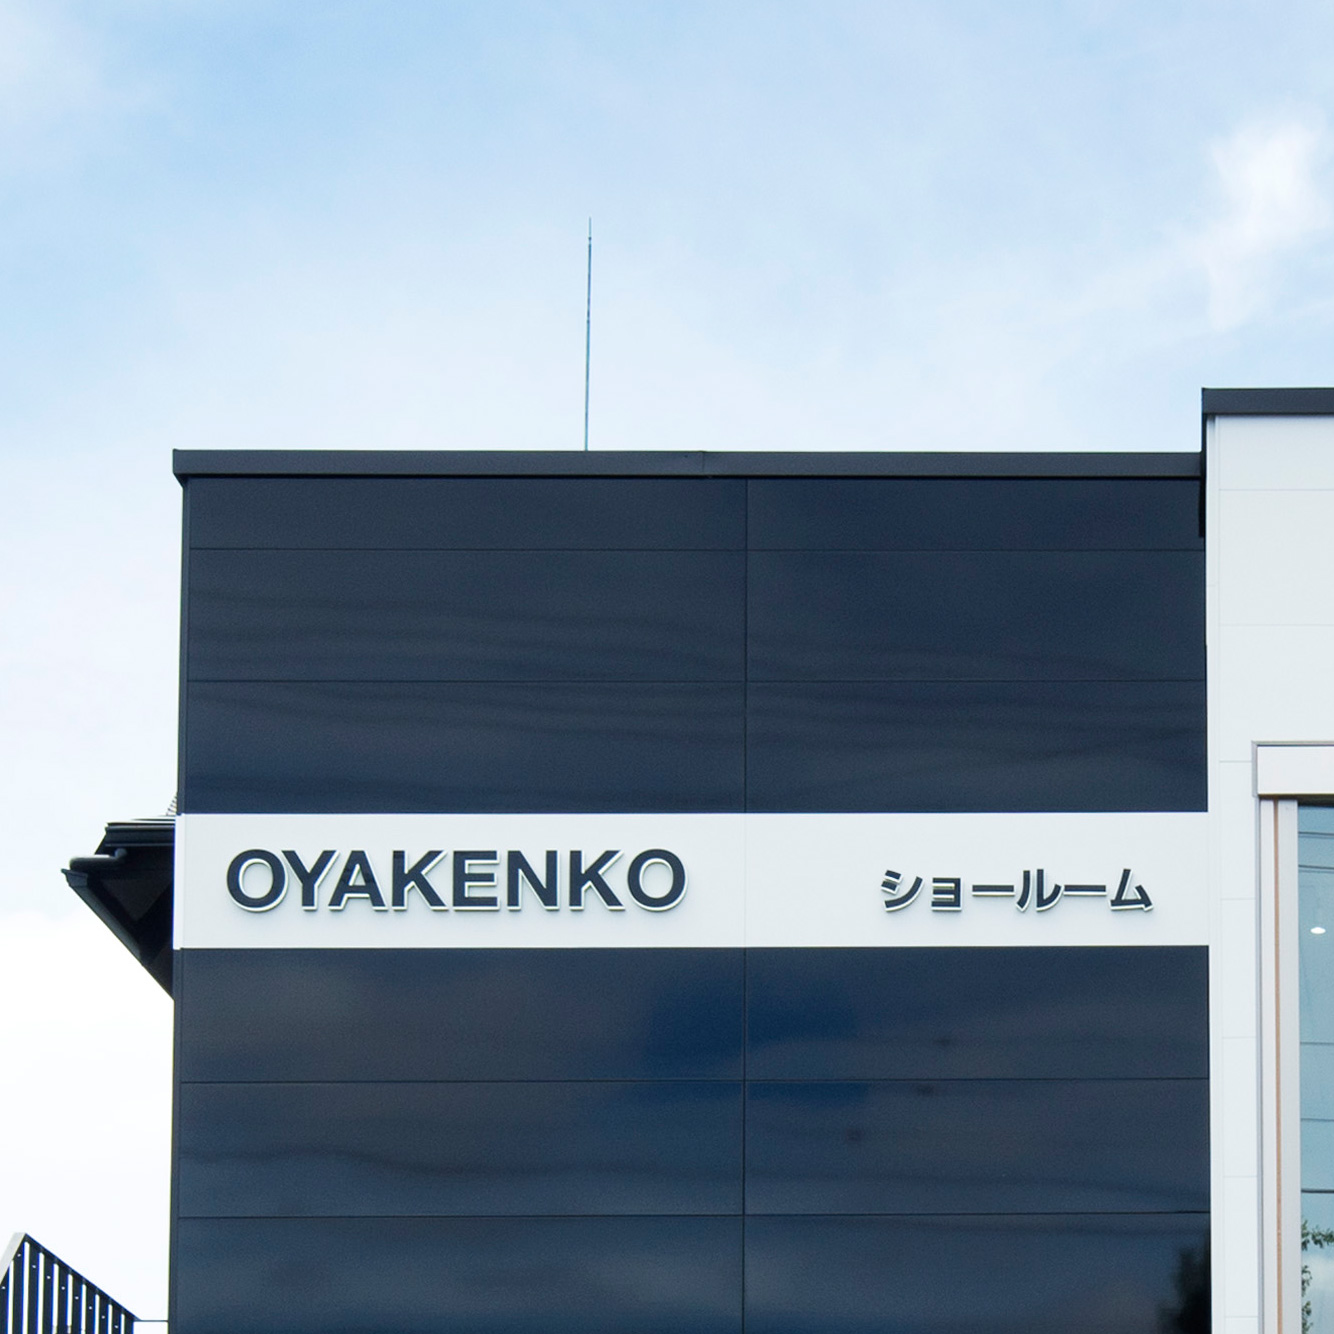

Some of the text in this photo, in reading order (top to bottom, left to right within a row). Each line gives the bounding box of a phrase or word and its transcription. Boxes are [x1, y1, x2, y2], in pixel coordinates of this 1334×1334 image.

[226, 848, 686, 912] OYAKENKO
[880, 868, 1154, 914] ショールーム
